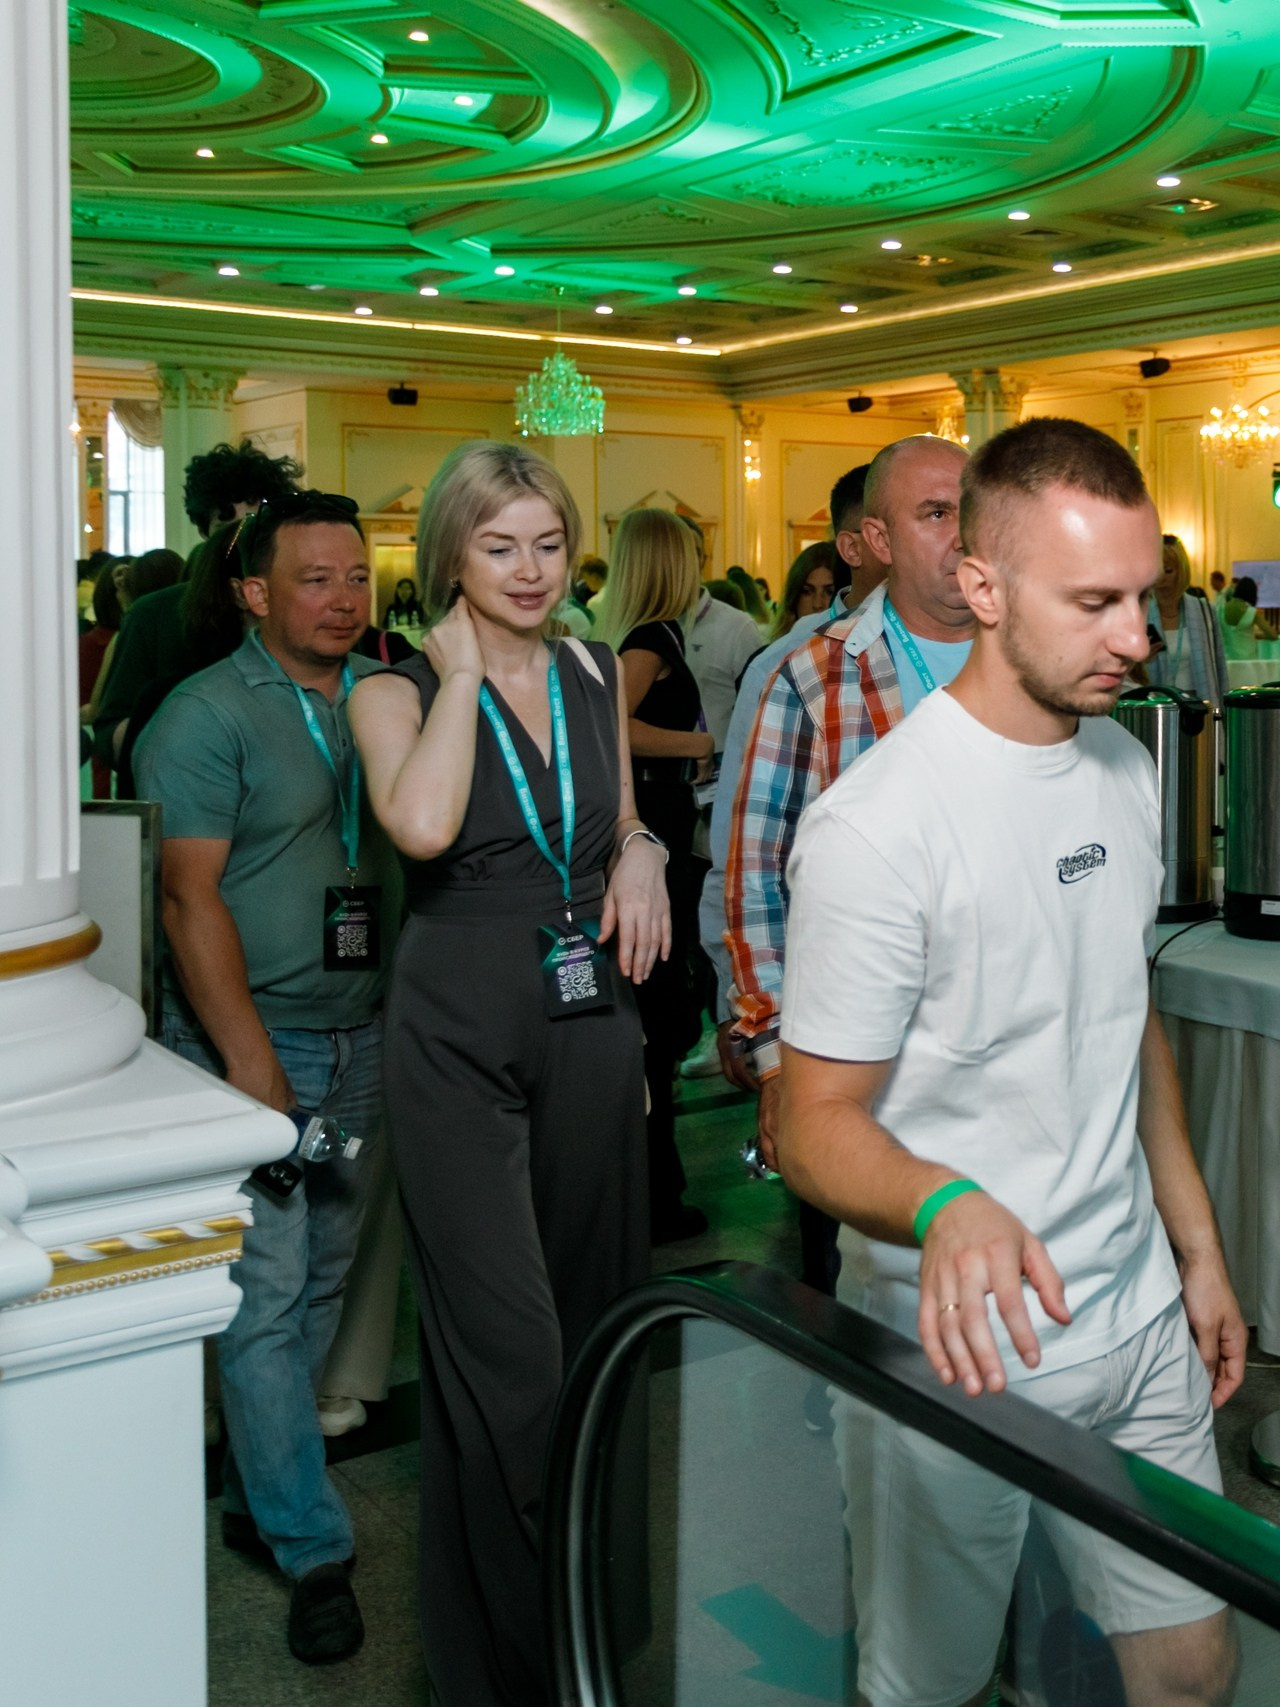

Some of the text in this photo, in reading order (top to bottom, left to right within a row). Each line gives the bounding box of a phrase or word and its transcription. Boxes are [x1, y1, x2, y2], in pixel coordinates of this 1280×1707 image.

[1056, 846, 1100, 868] chaotic
[1062, 858, 1106, 877] system
[566, 934, 584, 943] СБЕР
